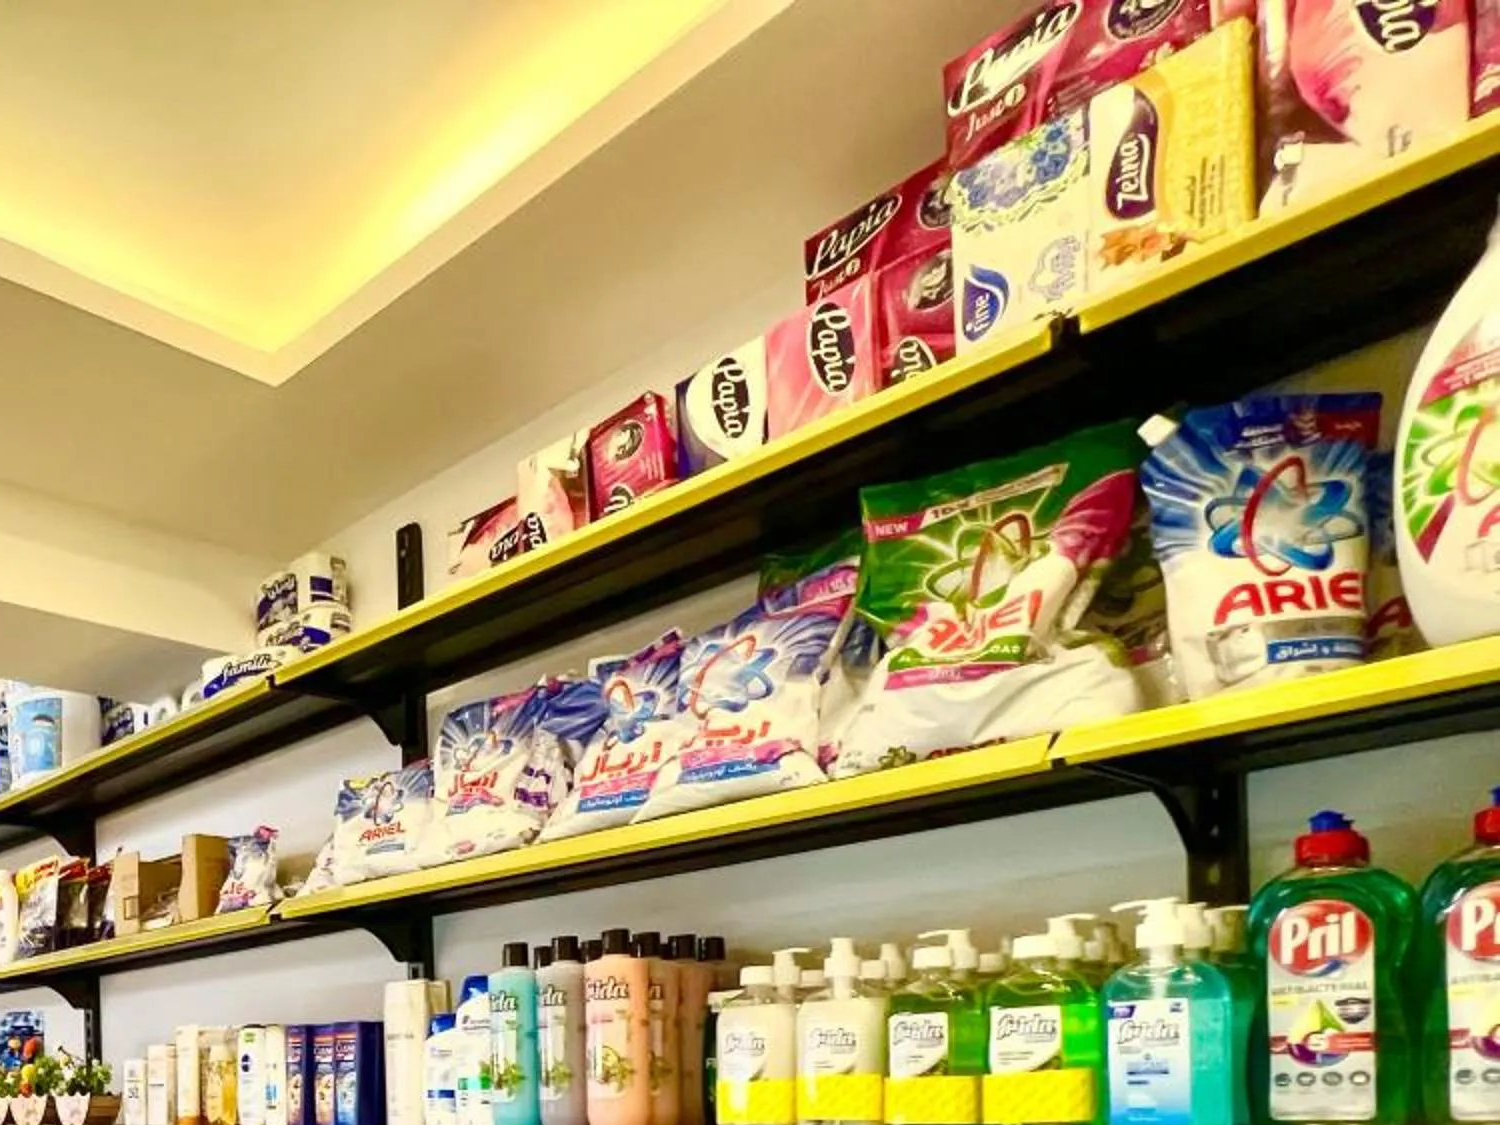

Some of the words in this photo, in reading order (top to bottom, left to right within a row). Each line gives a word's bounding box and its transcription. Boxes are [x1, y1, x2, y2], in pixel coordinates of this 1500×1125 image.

[810, 305, 856, 391] Papia
[710, 361, 750, 438] Papia
[875, 522, 909, 537] NEW
[1280, 910, 1357, 965] Pril
